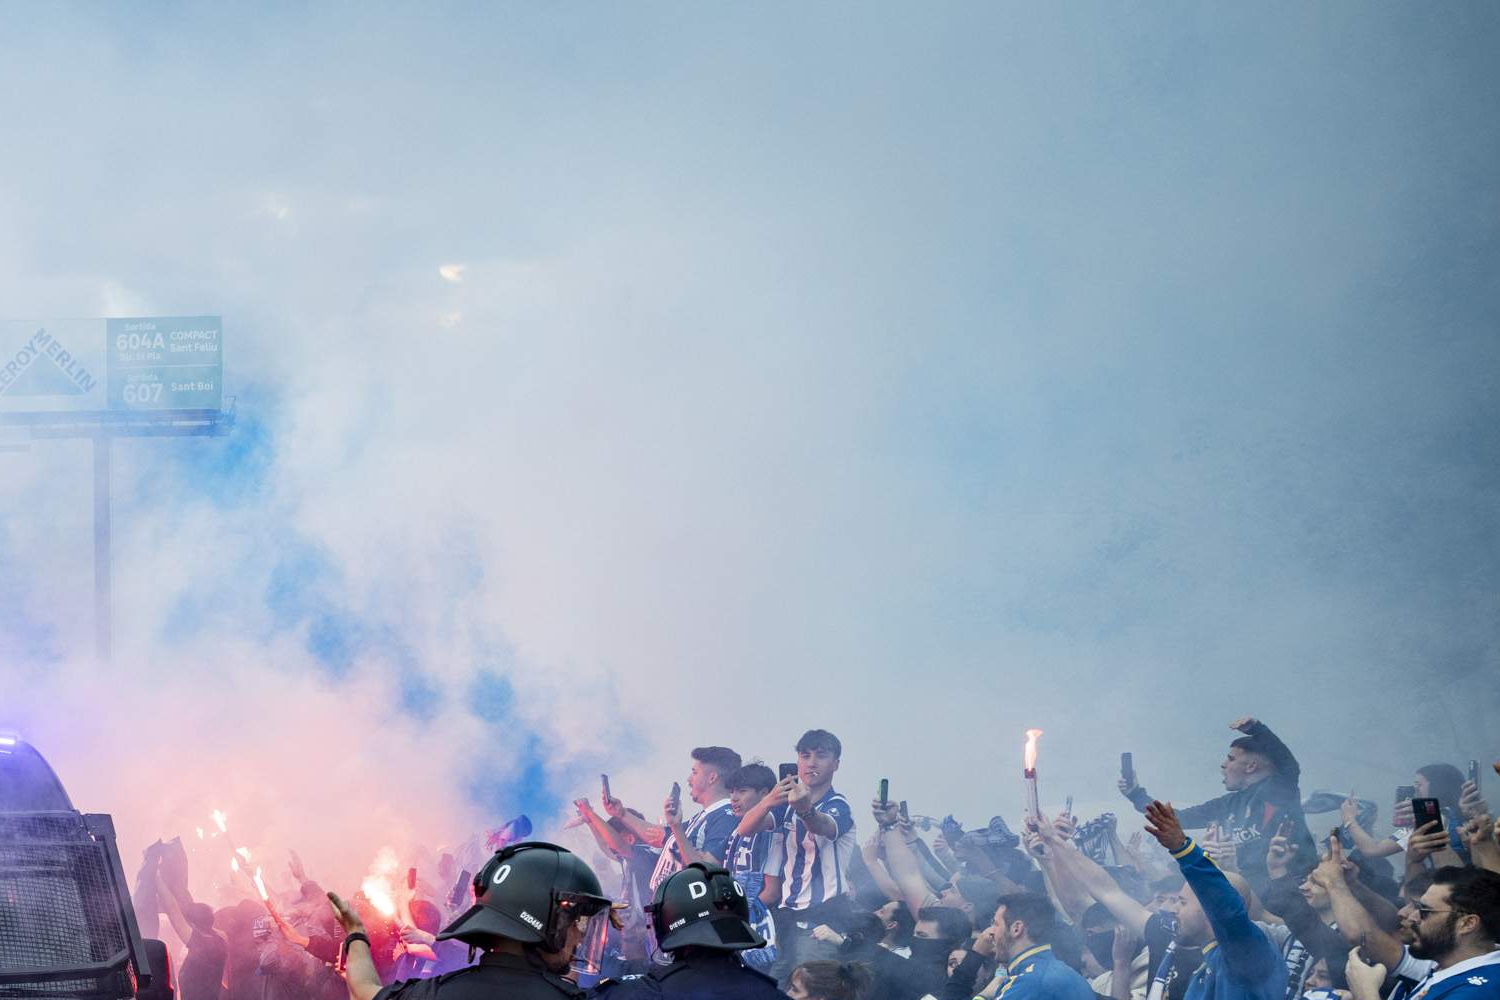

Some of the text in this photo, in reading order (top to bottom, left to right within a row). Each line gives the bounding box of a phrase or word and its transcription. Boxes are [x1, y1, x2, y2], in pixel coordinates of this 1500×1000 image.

[116, 332, 165, 351] 604A
[169, 330, 218, 341] COMPACT
[170, 342, 219, 353] Sant Feliu
[33, 327, 98, 393] MERLIN
[122, 383, 164, 403] 607
[171, 381, 214, 392] Sant Boi
[688, 880, 708, 901] D
